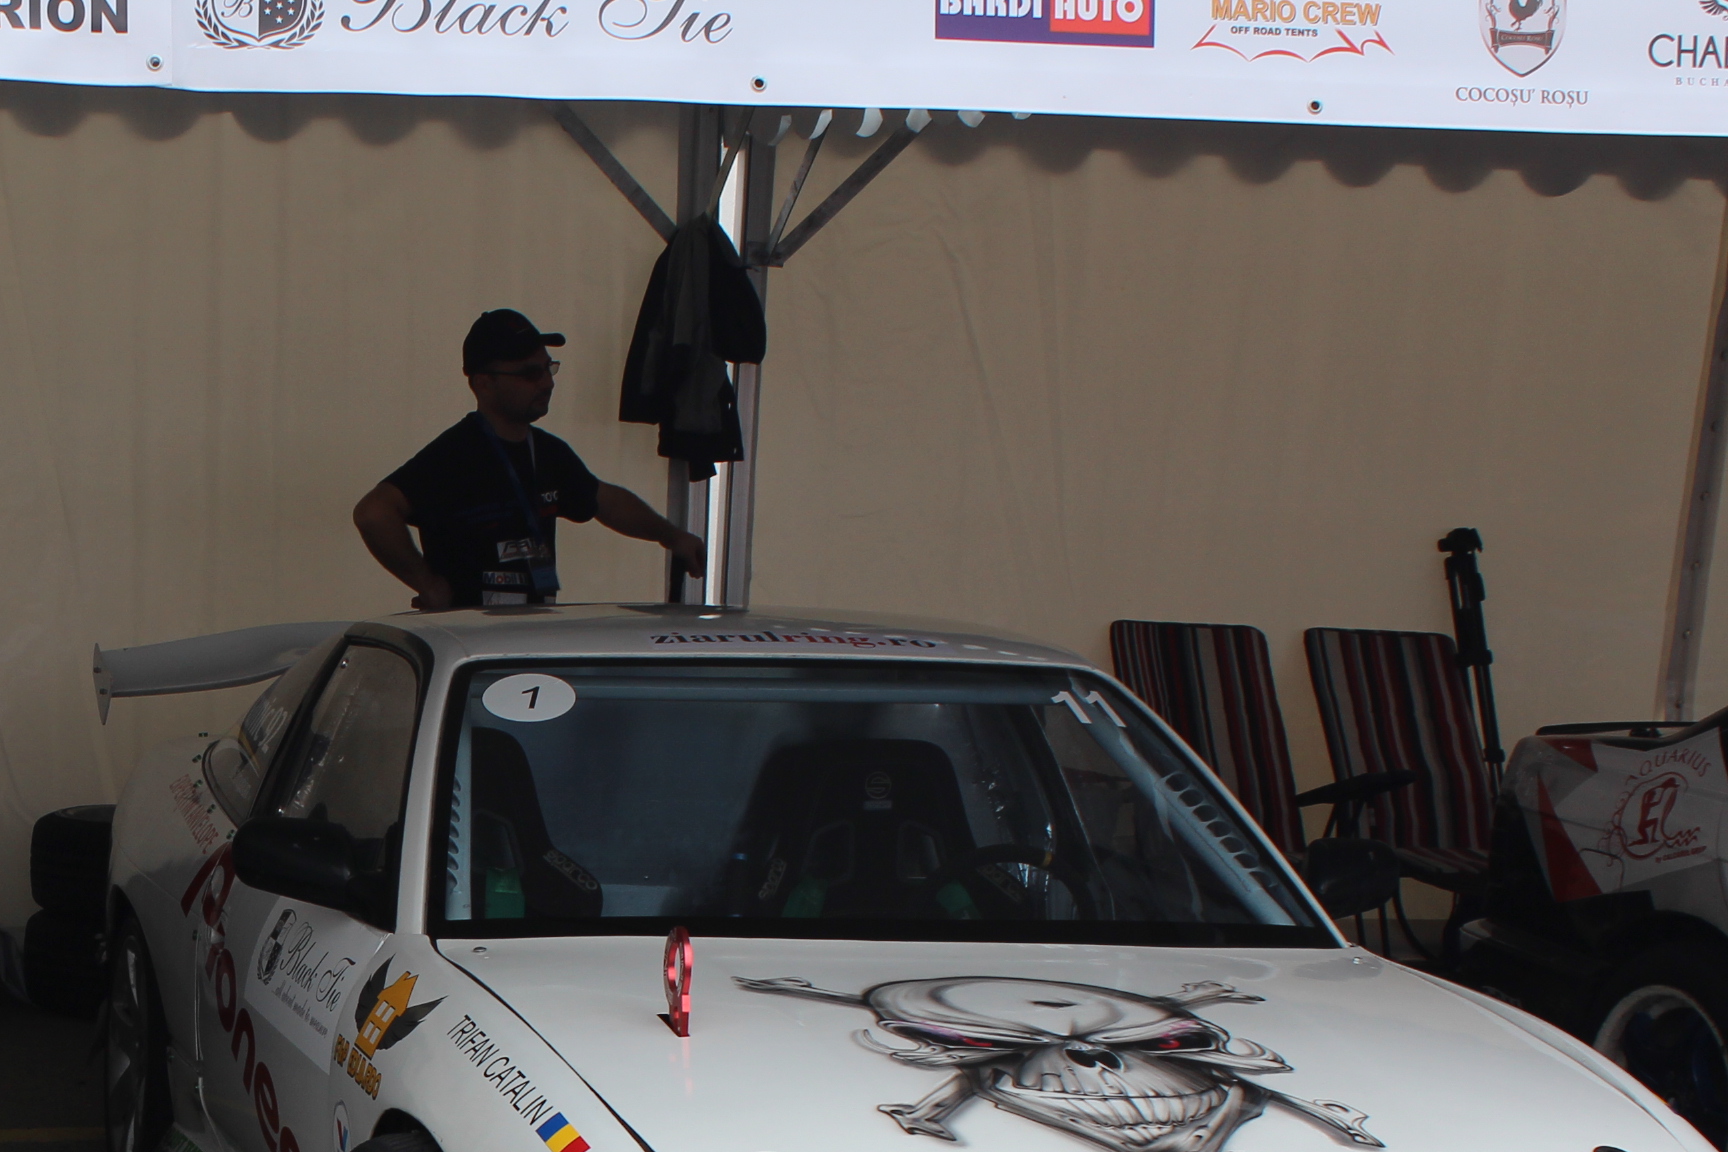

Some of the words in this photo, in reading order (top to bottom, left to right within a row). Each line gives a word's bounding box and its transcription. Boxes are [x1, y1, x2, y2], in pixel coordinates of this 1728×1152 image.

[1211, 0, 1296, 23] MARIO
[1303, 1, 1382, 26] CREW
[1230, 26, 1250, 34] OFF
[1253, 26, 1282, 35] ROAD
[1285, 28, 1319, 37] TENTS
[1648, 33, 1728, 69] CHA
[520, 686, 543, 710] 1
[446, 1013, 501, 1068] TRIFAN
[483, 1056, 554, 1126] CATALIN
